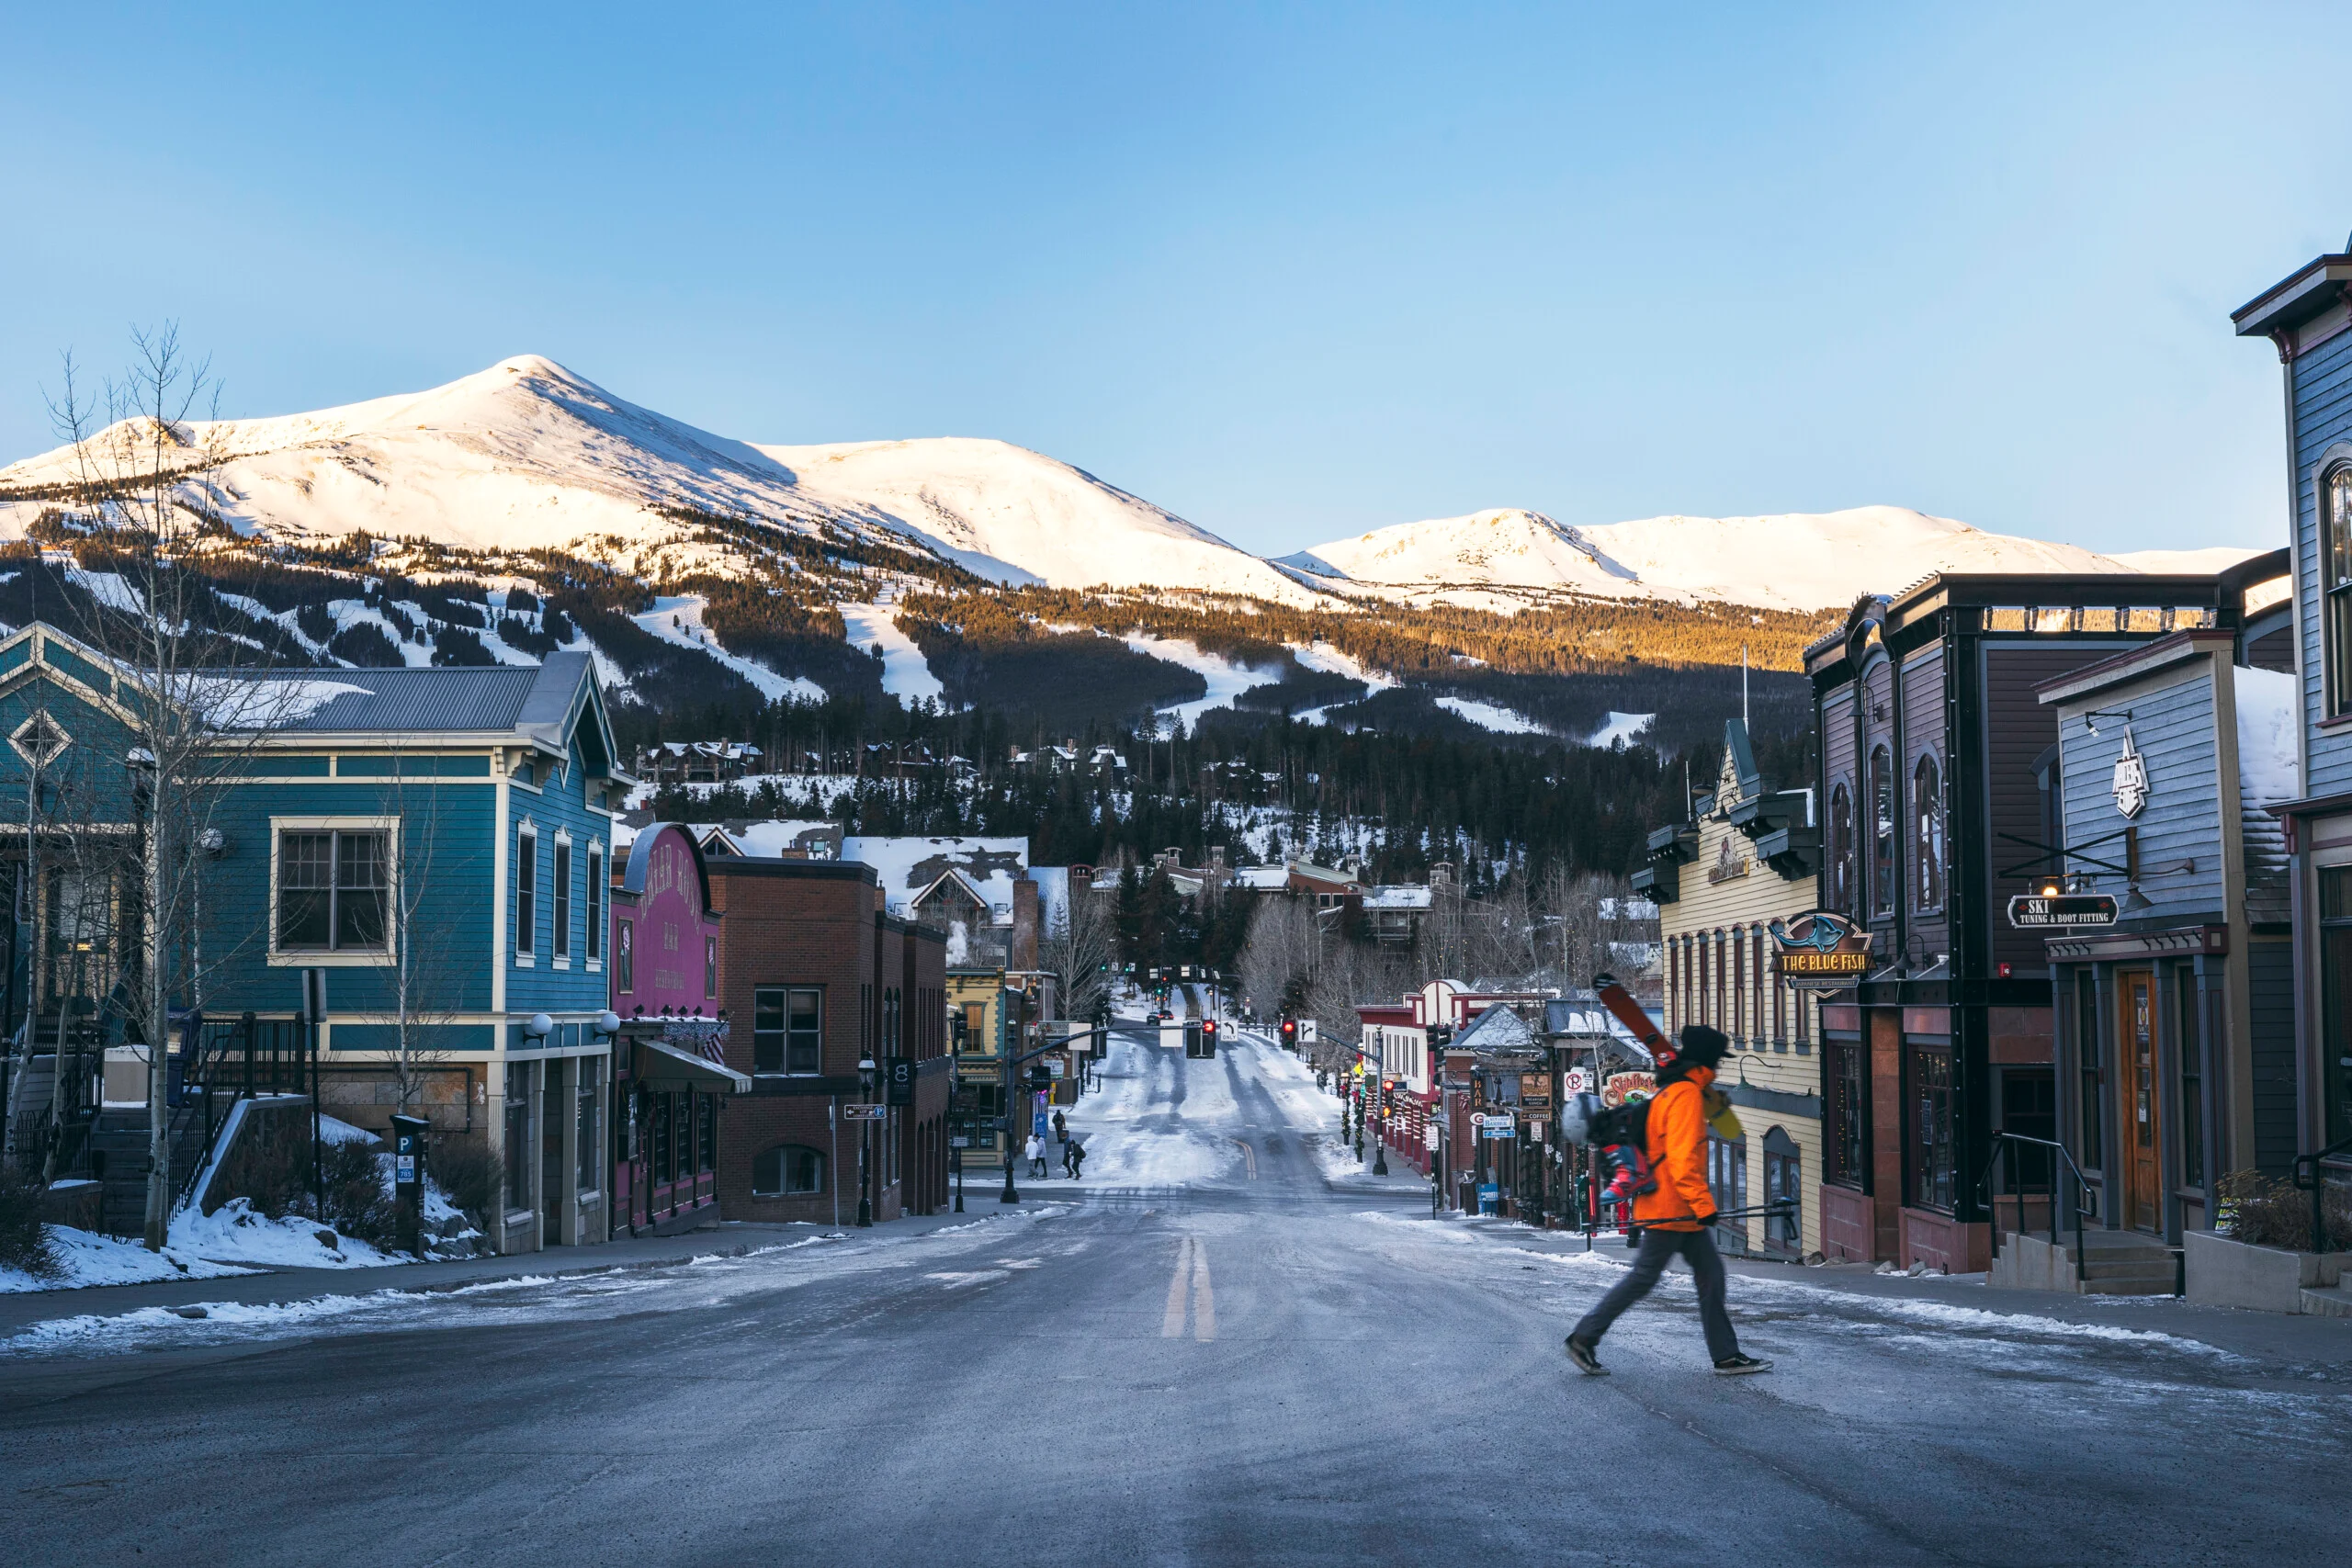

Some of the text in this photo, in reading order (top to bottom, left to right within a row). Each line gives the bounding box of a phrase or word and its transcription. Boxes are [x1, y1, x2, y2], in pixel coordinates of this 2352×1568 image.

[2028, 899, 2050, 914] SKI
[2020, 913, 2109, 924] TUNING & BOOT FITTING
[1474, 1080, 1482, 1107] BAR
[400, 1137, 410, 1151] P
